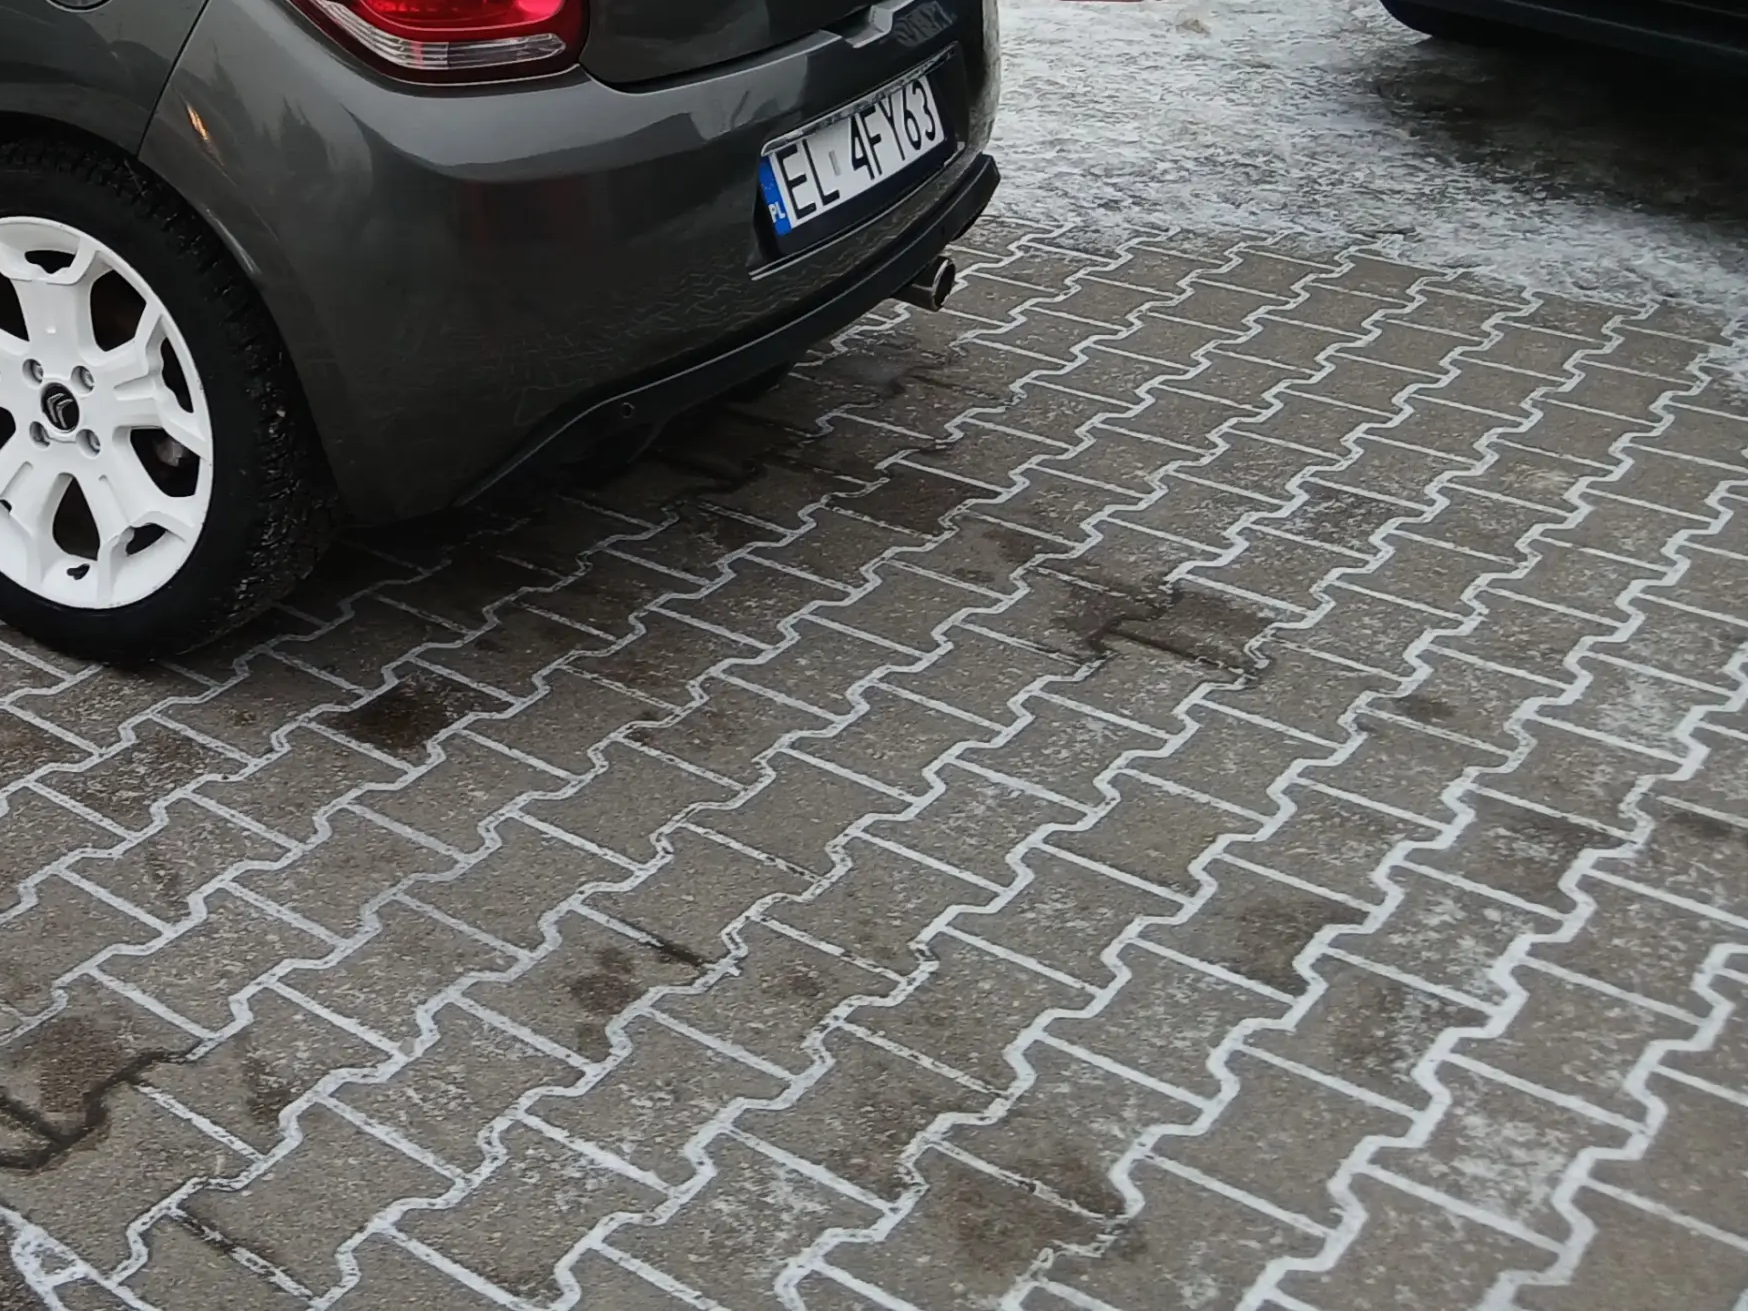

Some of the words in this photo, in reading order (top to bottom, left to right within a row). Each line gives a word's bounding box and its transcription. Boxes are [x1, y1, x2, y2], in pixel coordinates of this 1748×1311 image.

[852, 79, 937, 181] 4FY63
[768, 201, 786, 223] PL
[775, 139, 840, 220] EL
